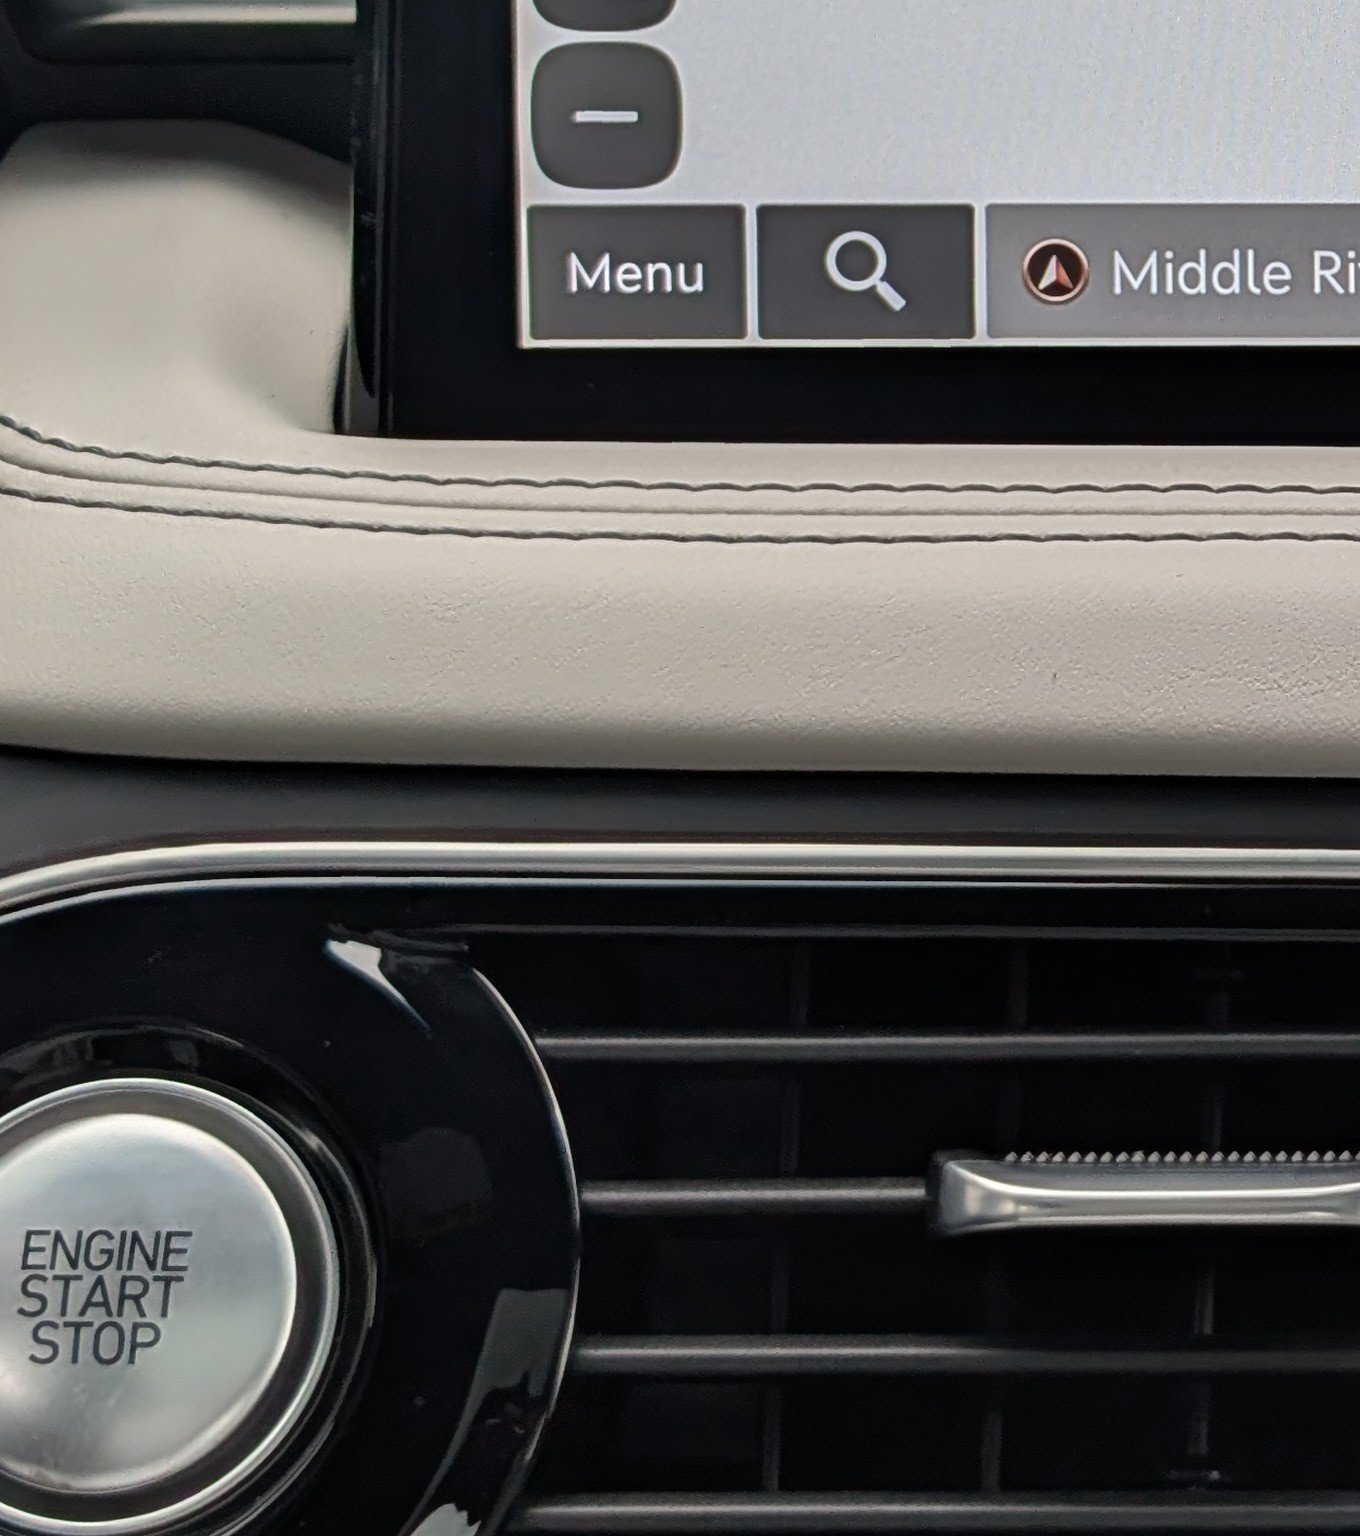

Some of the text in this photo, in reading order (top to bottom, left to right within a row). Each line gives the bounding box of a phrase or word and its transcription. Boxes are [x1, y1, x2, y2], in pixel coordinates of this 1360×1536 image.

[566, 251, 705, 294] Menu
[1111, 249, 1292, 296] Middle
[20, 1229, 193, 1272] ENGINE
[17, 1275, 184, 1318] START
[28, 1321, 162, 1365] STOP
